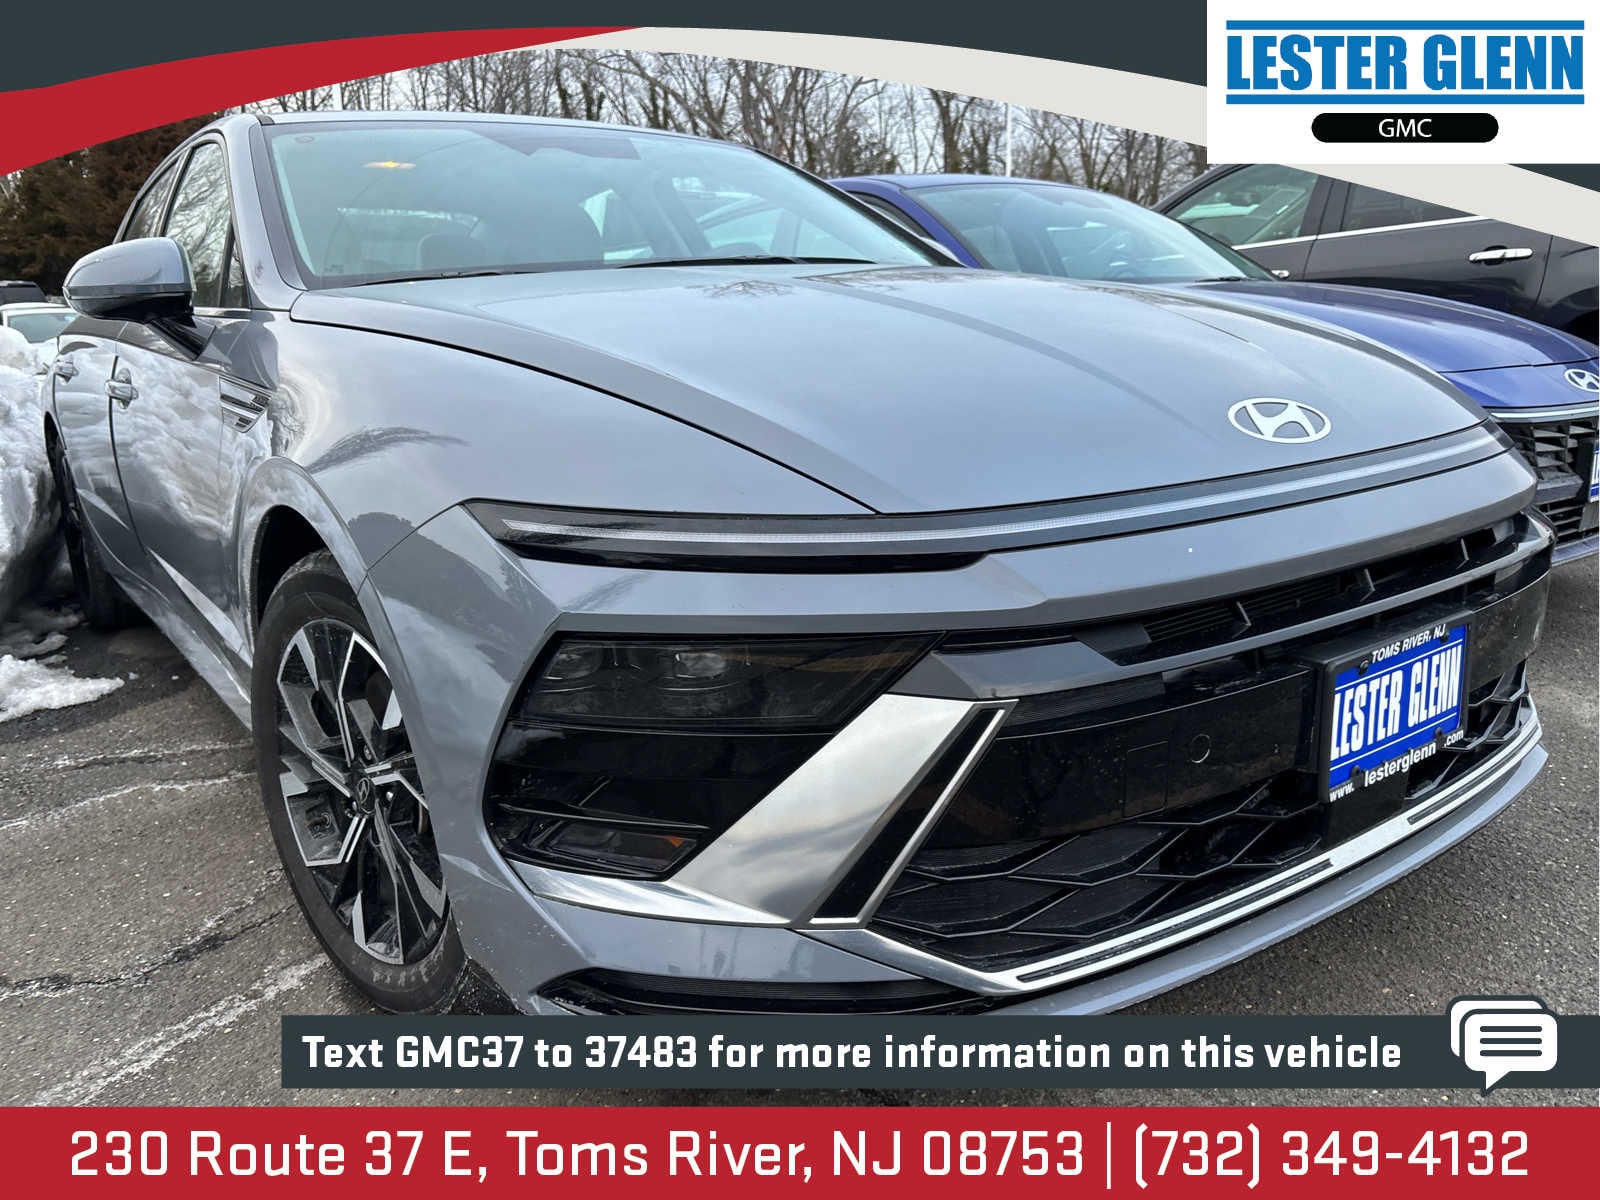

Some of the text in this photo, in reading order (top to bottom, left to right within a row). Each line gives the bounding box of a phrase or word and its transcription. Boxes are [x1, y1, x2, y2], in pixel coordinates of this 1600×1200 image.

[1371, 623, 1447, 663] TOMS RIVER, NJ
[1330, 645, 1463, 761] LESTER GLENN
[1329, 729, 1464, 803] www. lesterglenn .com
